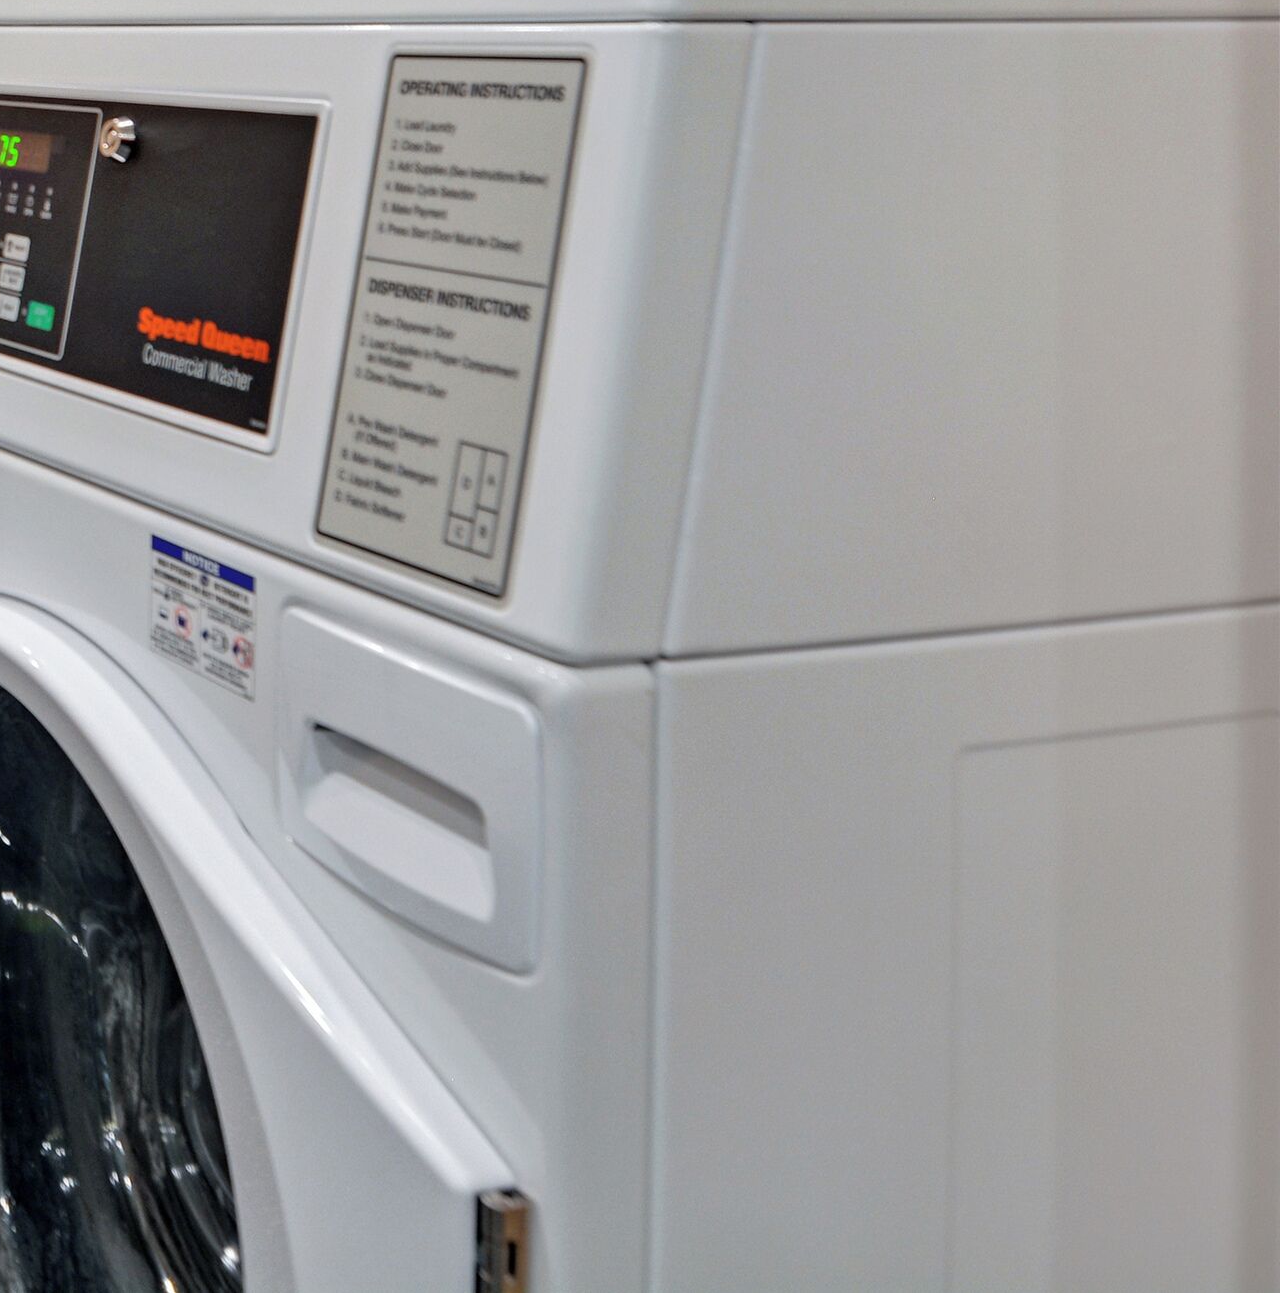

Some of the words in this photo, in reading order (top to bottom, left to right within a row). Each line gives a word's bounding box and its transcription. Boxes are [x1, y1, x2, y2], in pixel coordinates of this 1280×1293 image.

[400, 79, 468, 97] OPERATING
[470, 82, 566, 102] INSTRUCTIONS
[369, 277, 435, 301] DISPENSER
[437, 290, 531, 322] INSTRUCTIONS
[137, 306, 202, 346] Speed
[201, 320, 271, 364] Queen
[142, 342, 208, 380] Commercial
[207, 360, 254, 392] Washer
[182, 549, 221, 577] NOTICE
